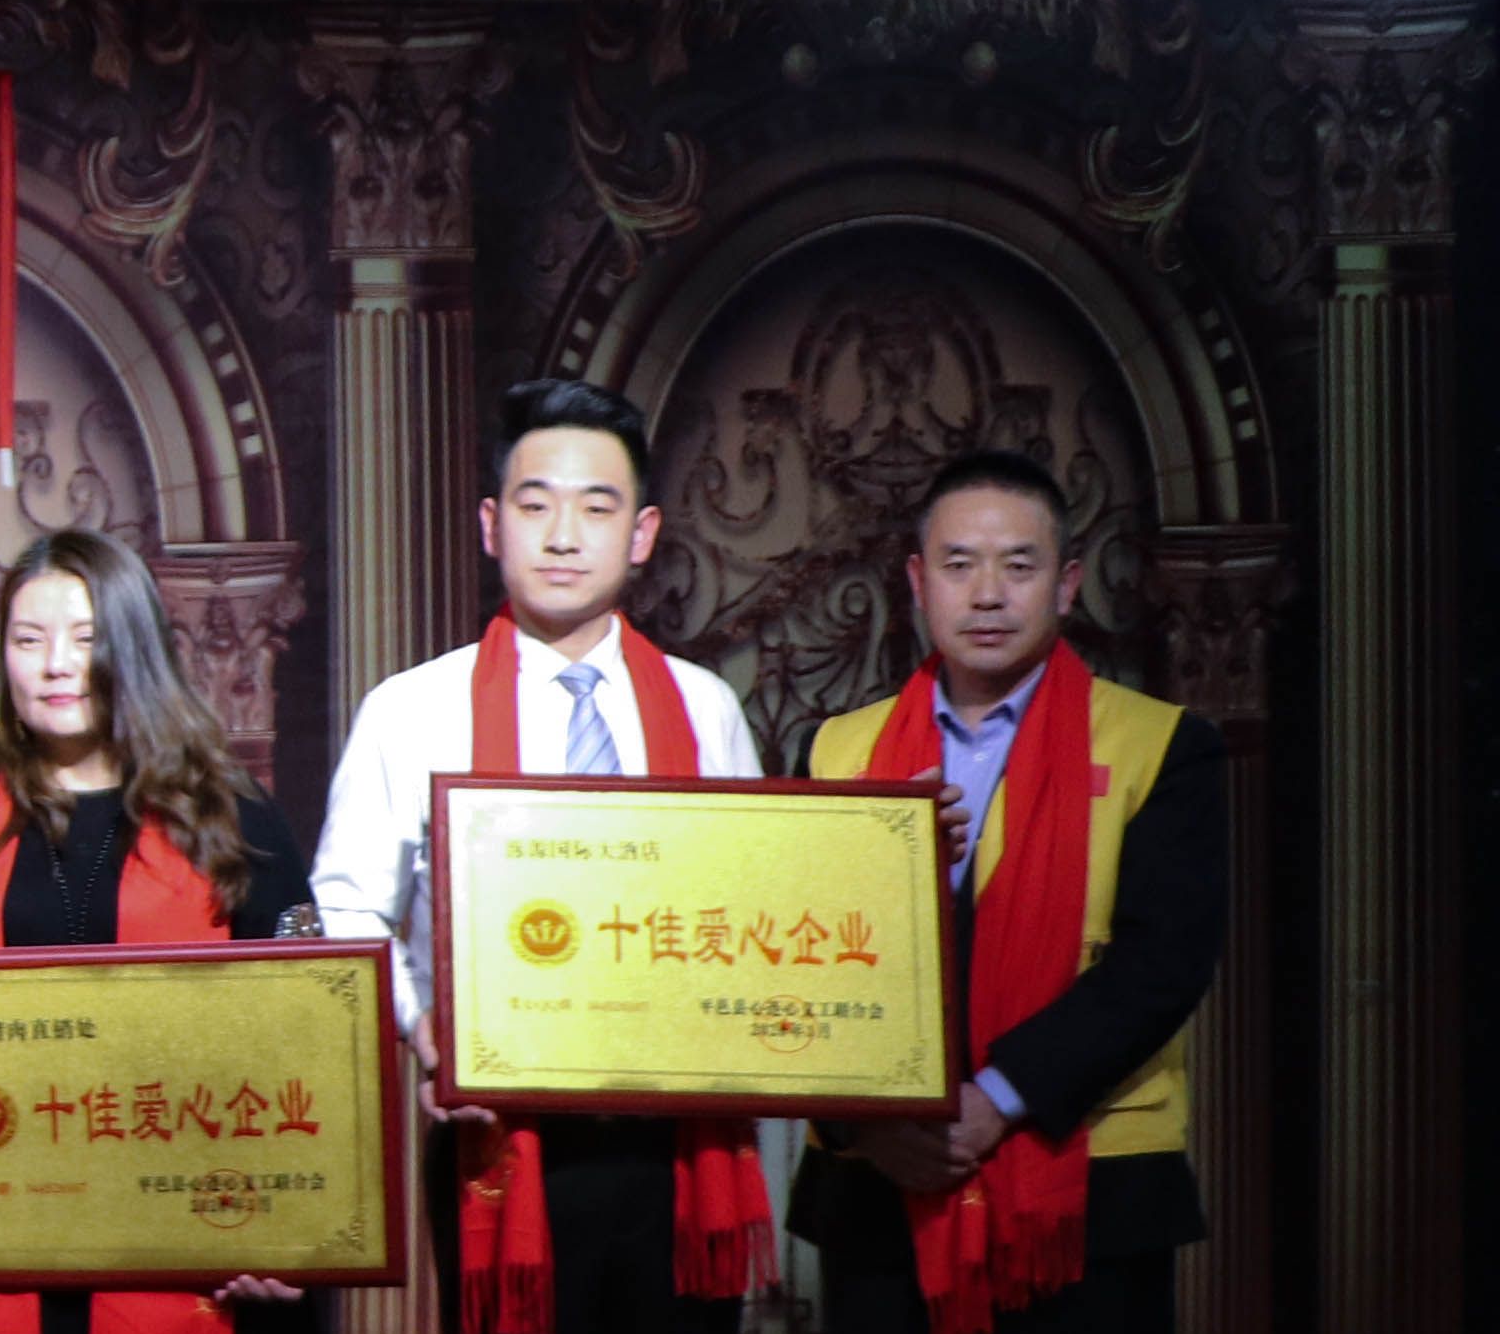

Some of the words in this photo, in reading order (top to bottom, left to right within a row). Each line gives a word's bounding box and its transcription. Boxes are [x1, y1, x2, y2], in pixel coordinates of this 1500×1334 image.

[598, 903, 880, 967] 十佳爱心企业
[34, 1078, 321, 1144] 十佳爱心企业
